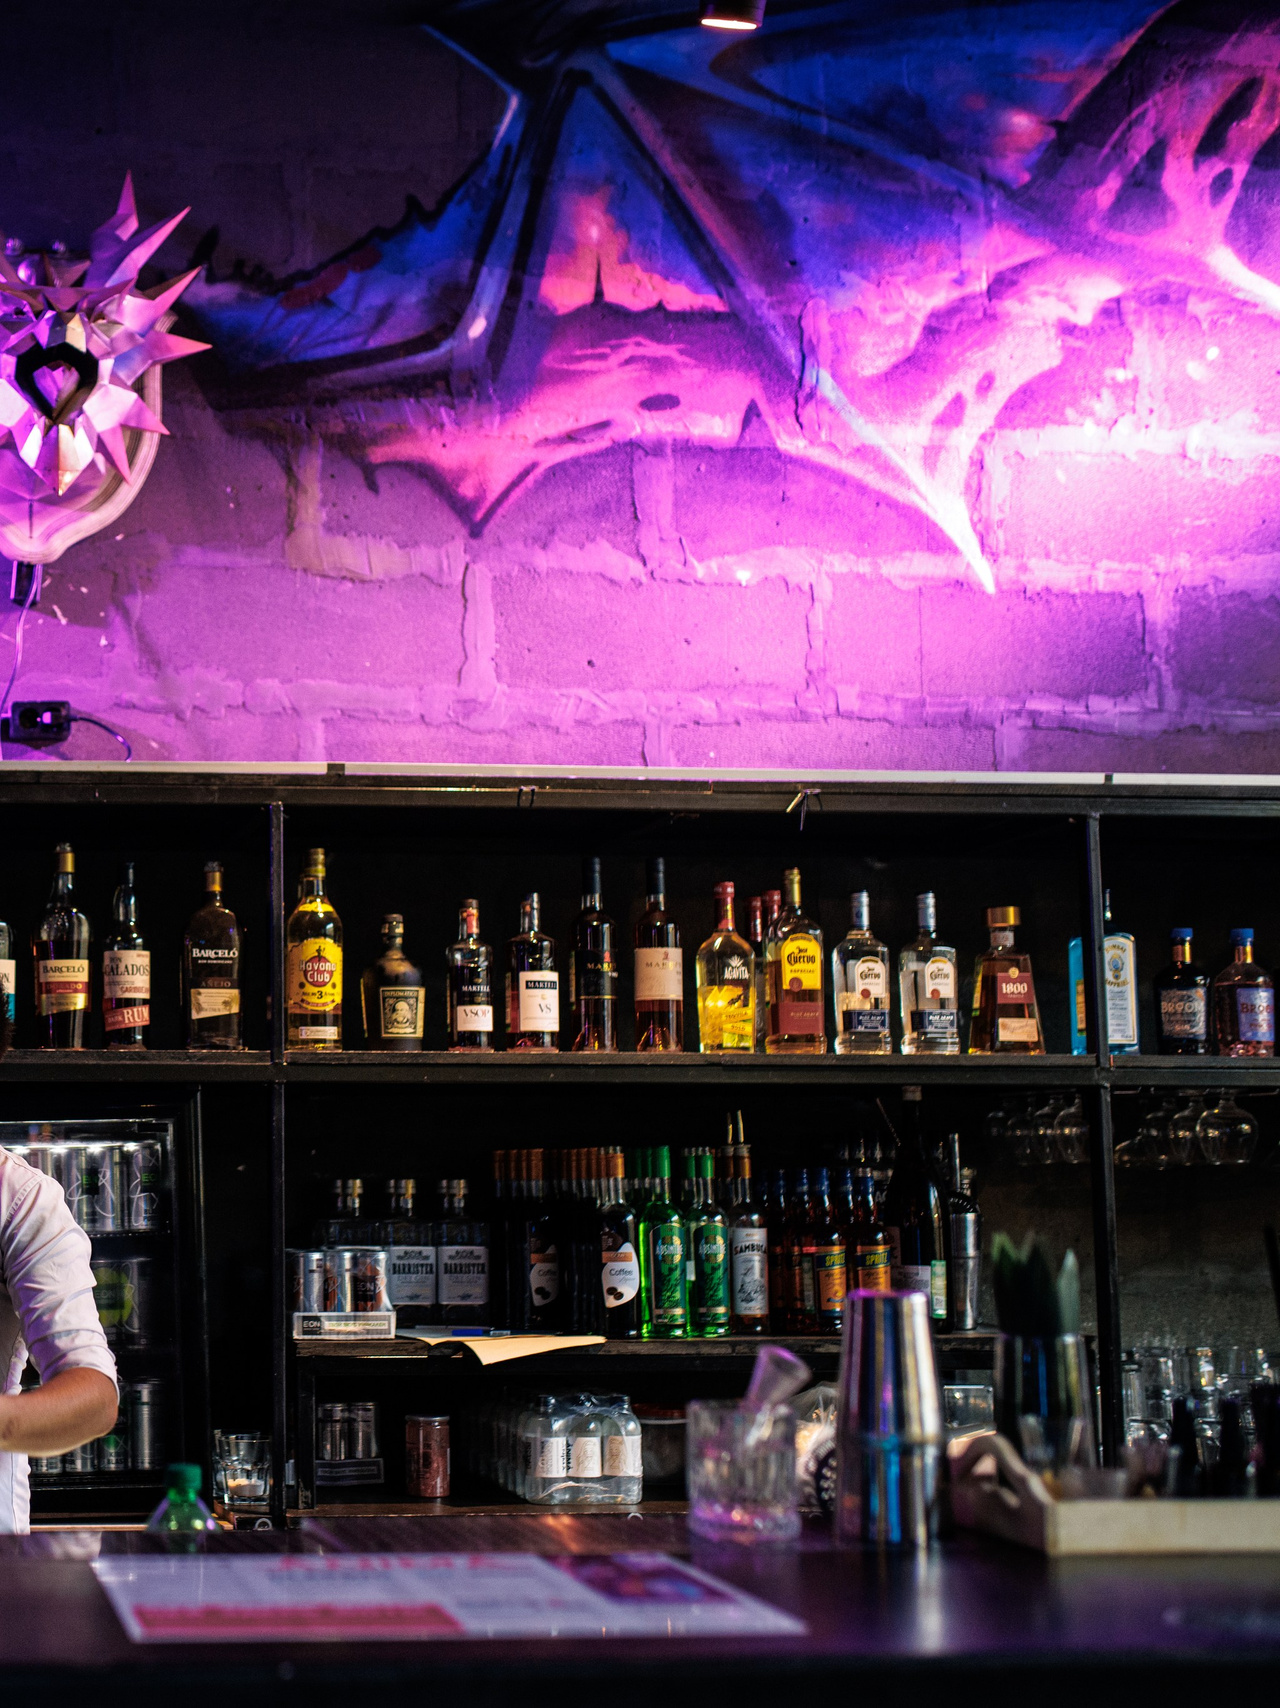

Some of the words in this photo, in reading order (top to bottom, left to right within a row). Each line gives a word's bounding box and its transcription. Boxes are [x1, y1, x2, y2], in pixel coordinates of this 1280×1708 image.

[192, 947, 239, 959] BARCELÓ
[787, 951, 816, 966] Cuervo
[42, 964, 85, 974] BARCELÓ
[104, 963, 150, 977] CALADOS
[300, 961, 337, 972] Havana
[307, 971, 331, 982] Club
[723, 966, 750, 980] AGAVITA
[200, 979, 232, 988] AÑEJO
[1001, 982, 1028, 995] 1800
[317, 990, 323, 999] 3
[463, 1008, 490, 1018] VSOP
[538, 1002, 552, 1014] VS
[123, 1006, 150, 1024] RUM
[392, 1263, 434, 1275] BARRISTER
[443, 1262, 487, 1275] BARRISTER
[609, 1268, 634, 1277] Coffee
[303, 1320, 321, 1328] EON
